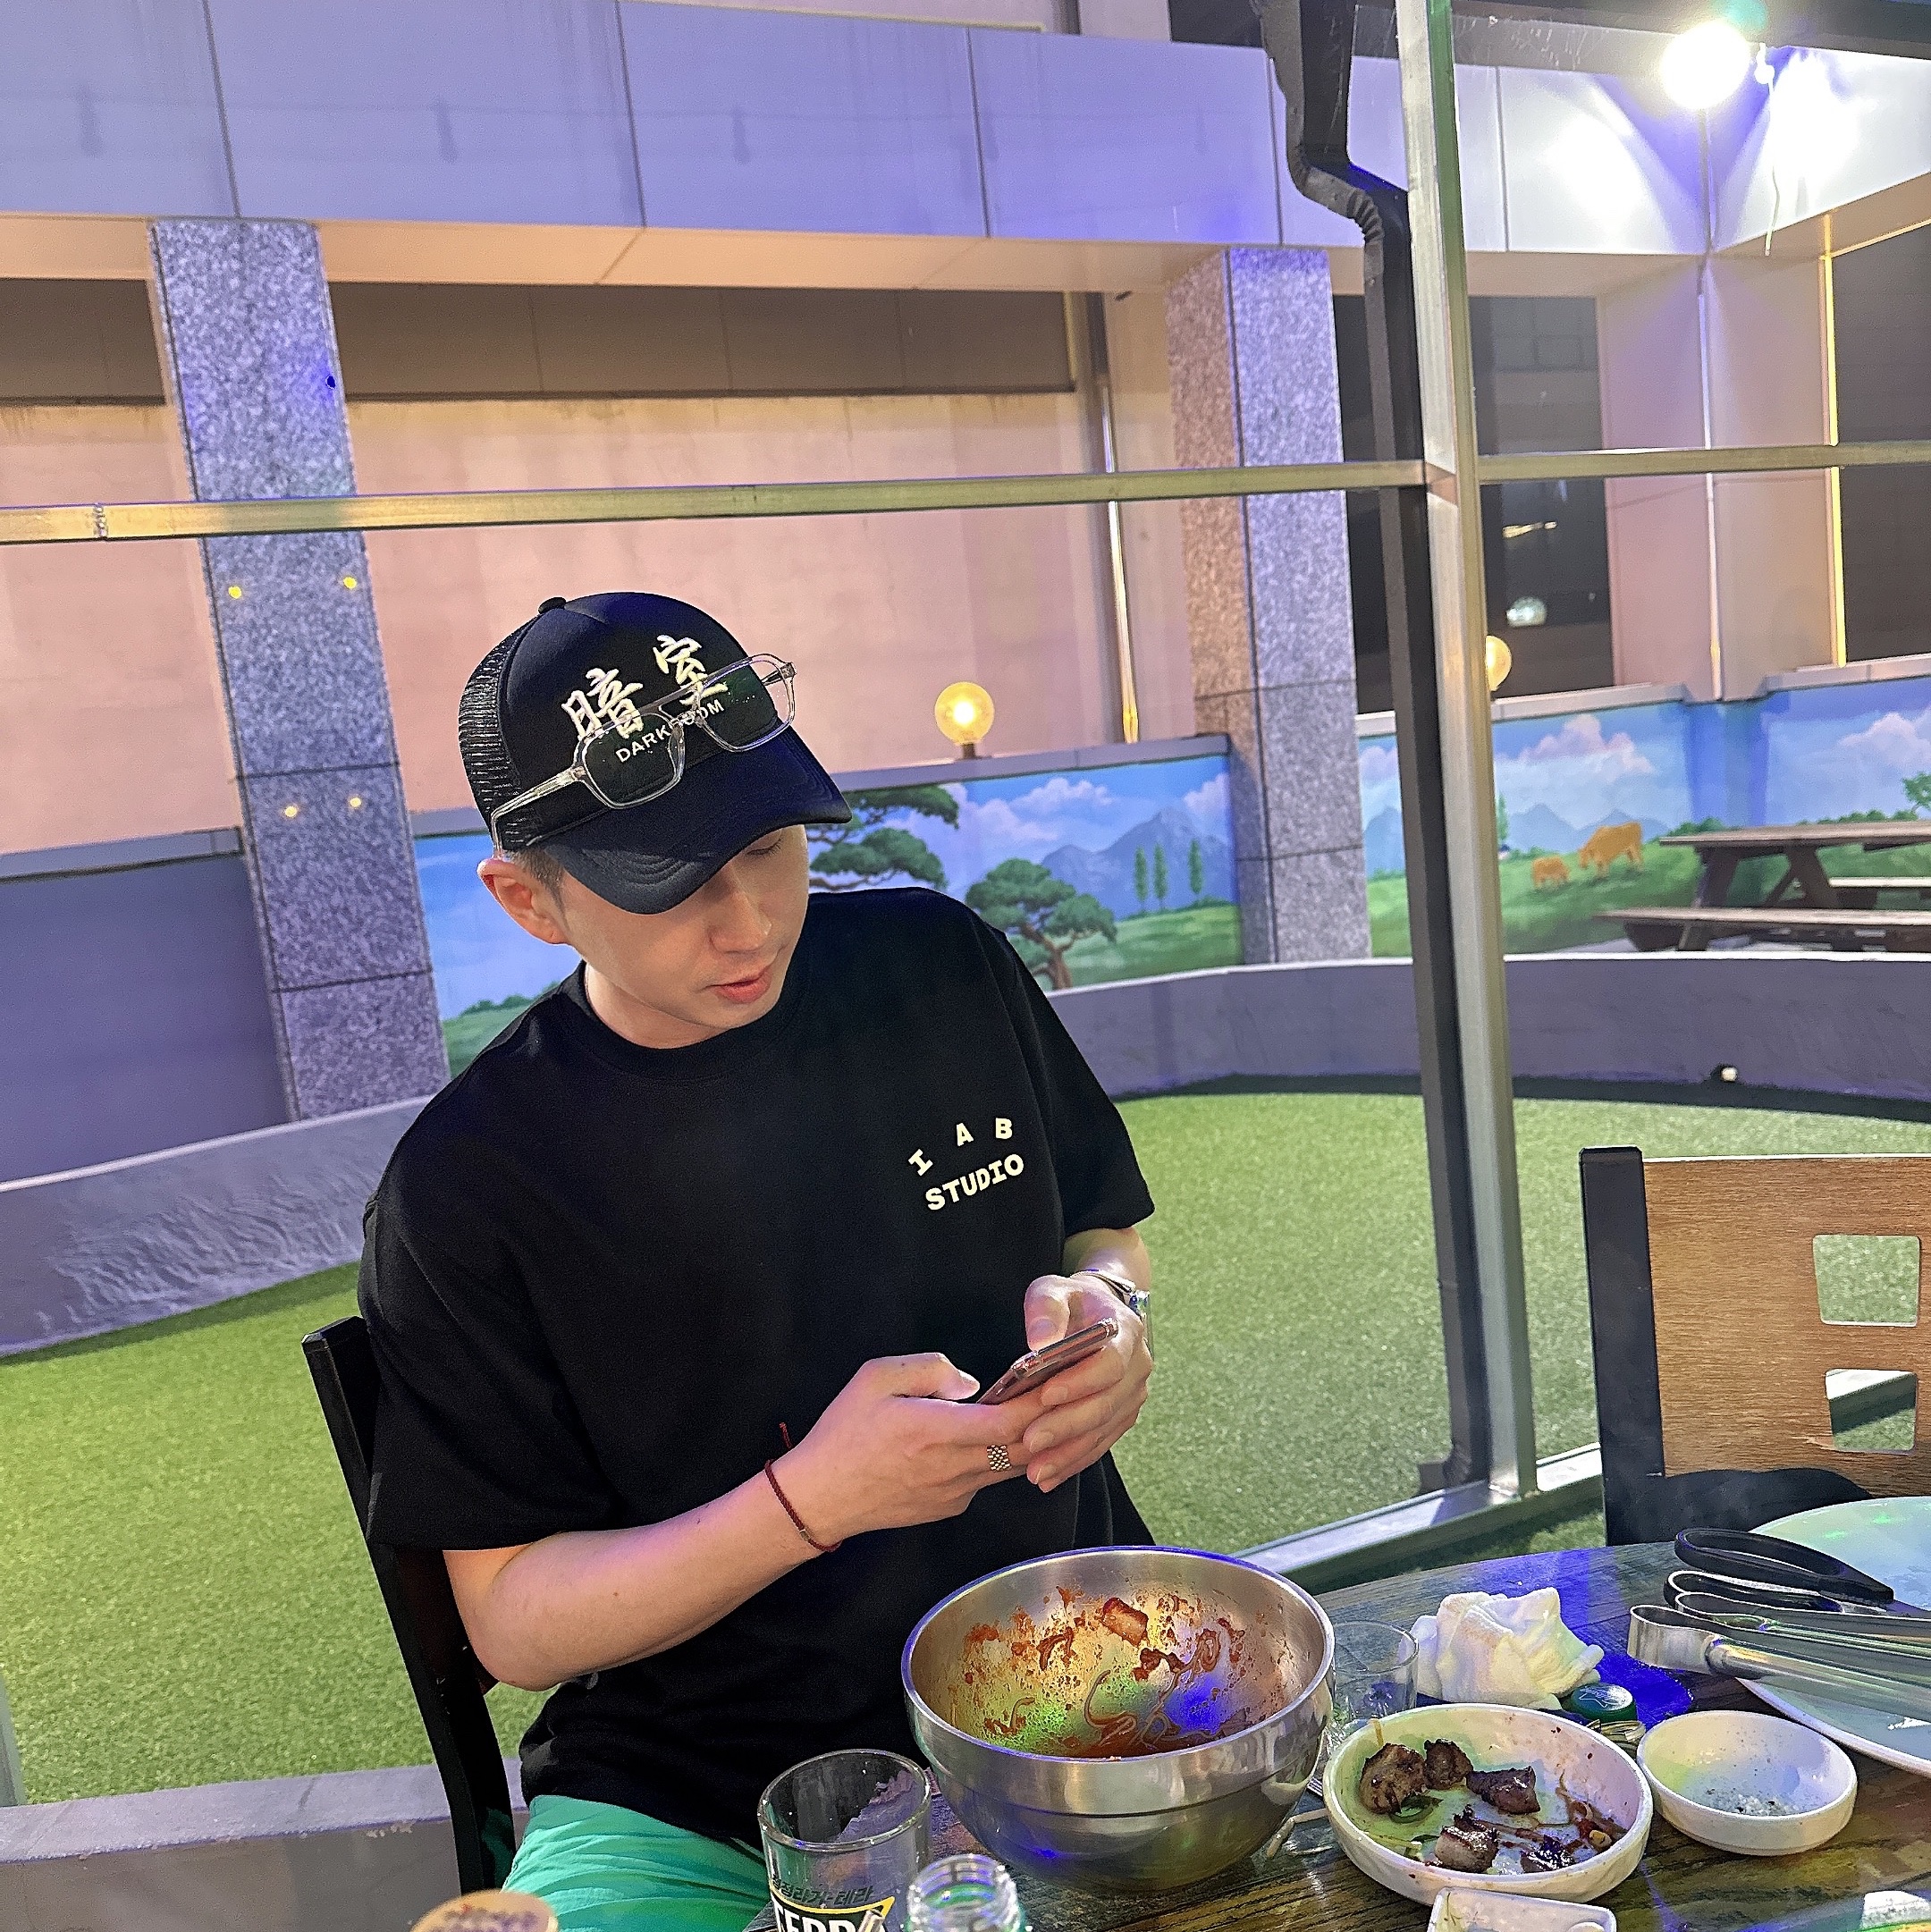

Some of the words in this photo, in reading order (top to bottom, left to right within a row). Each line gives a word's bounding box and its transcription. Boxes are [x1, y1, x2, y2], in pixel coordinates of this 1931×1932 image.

[561, 635, 729, 739] 暗室
[615, 698, 725, 763] DARKOOM
[925, 1153, 1025, 1211] STUDIO
